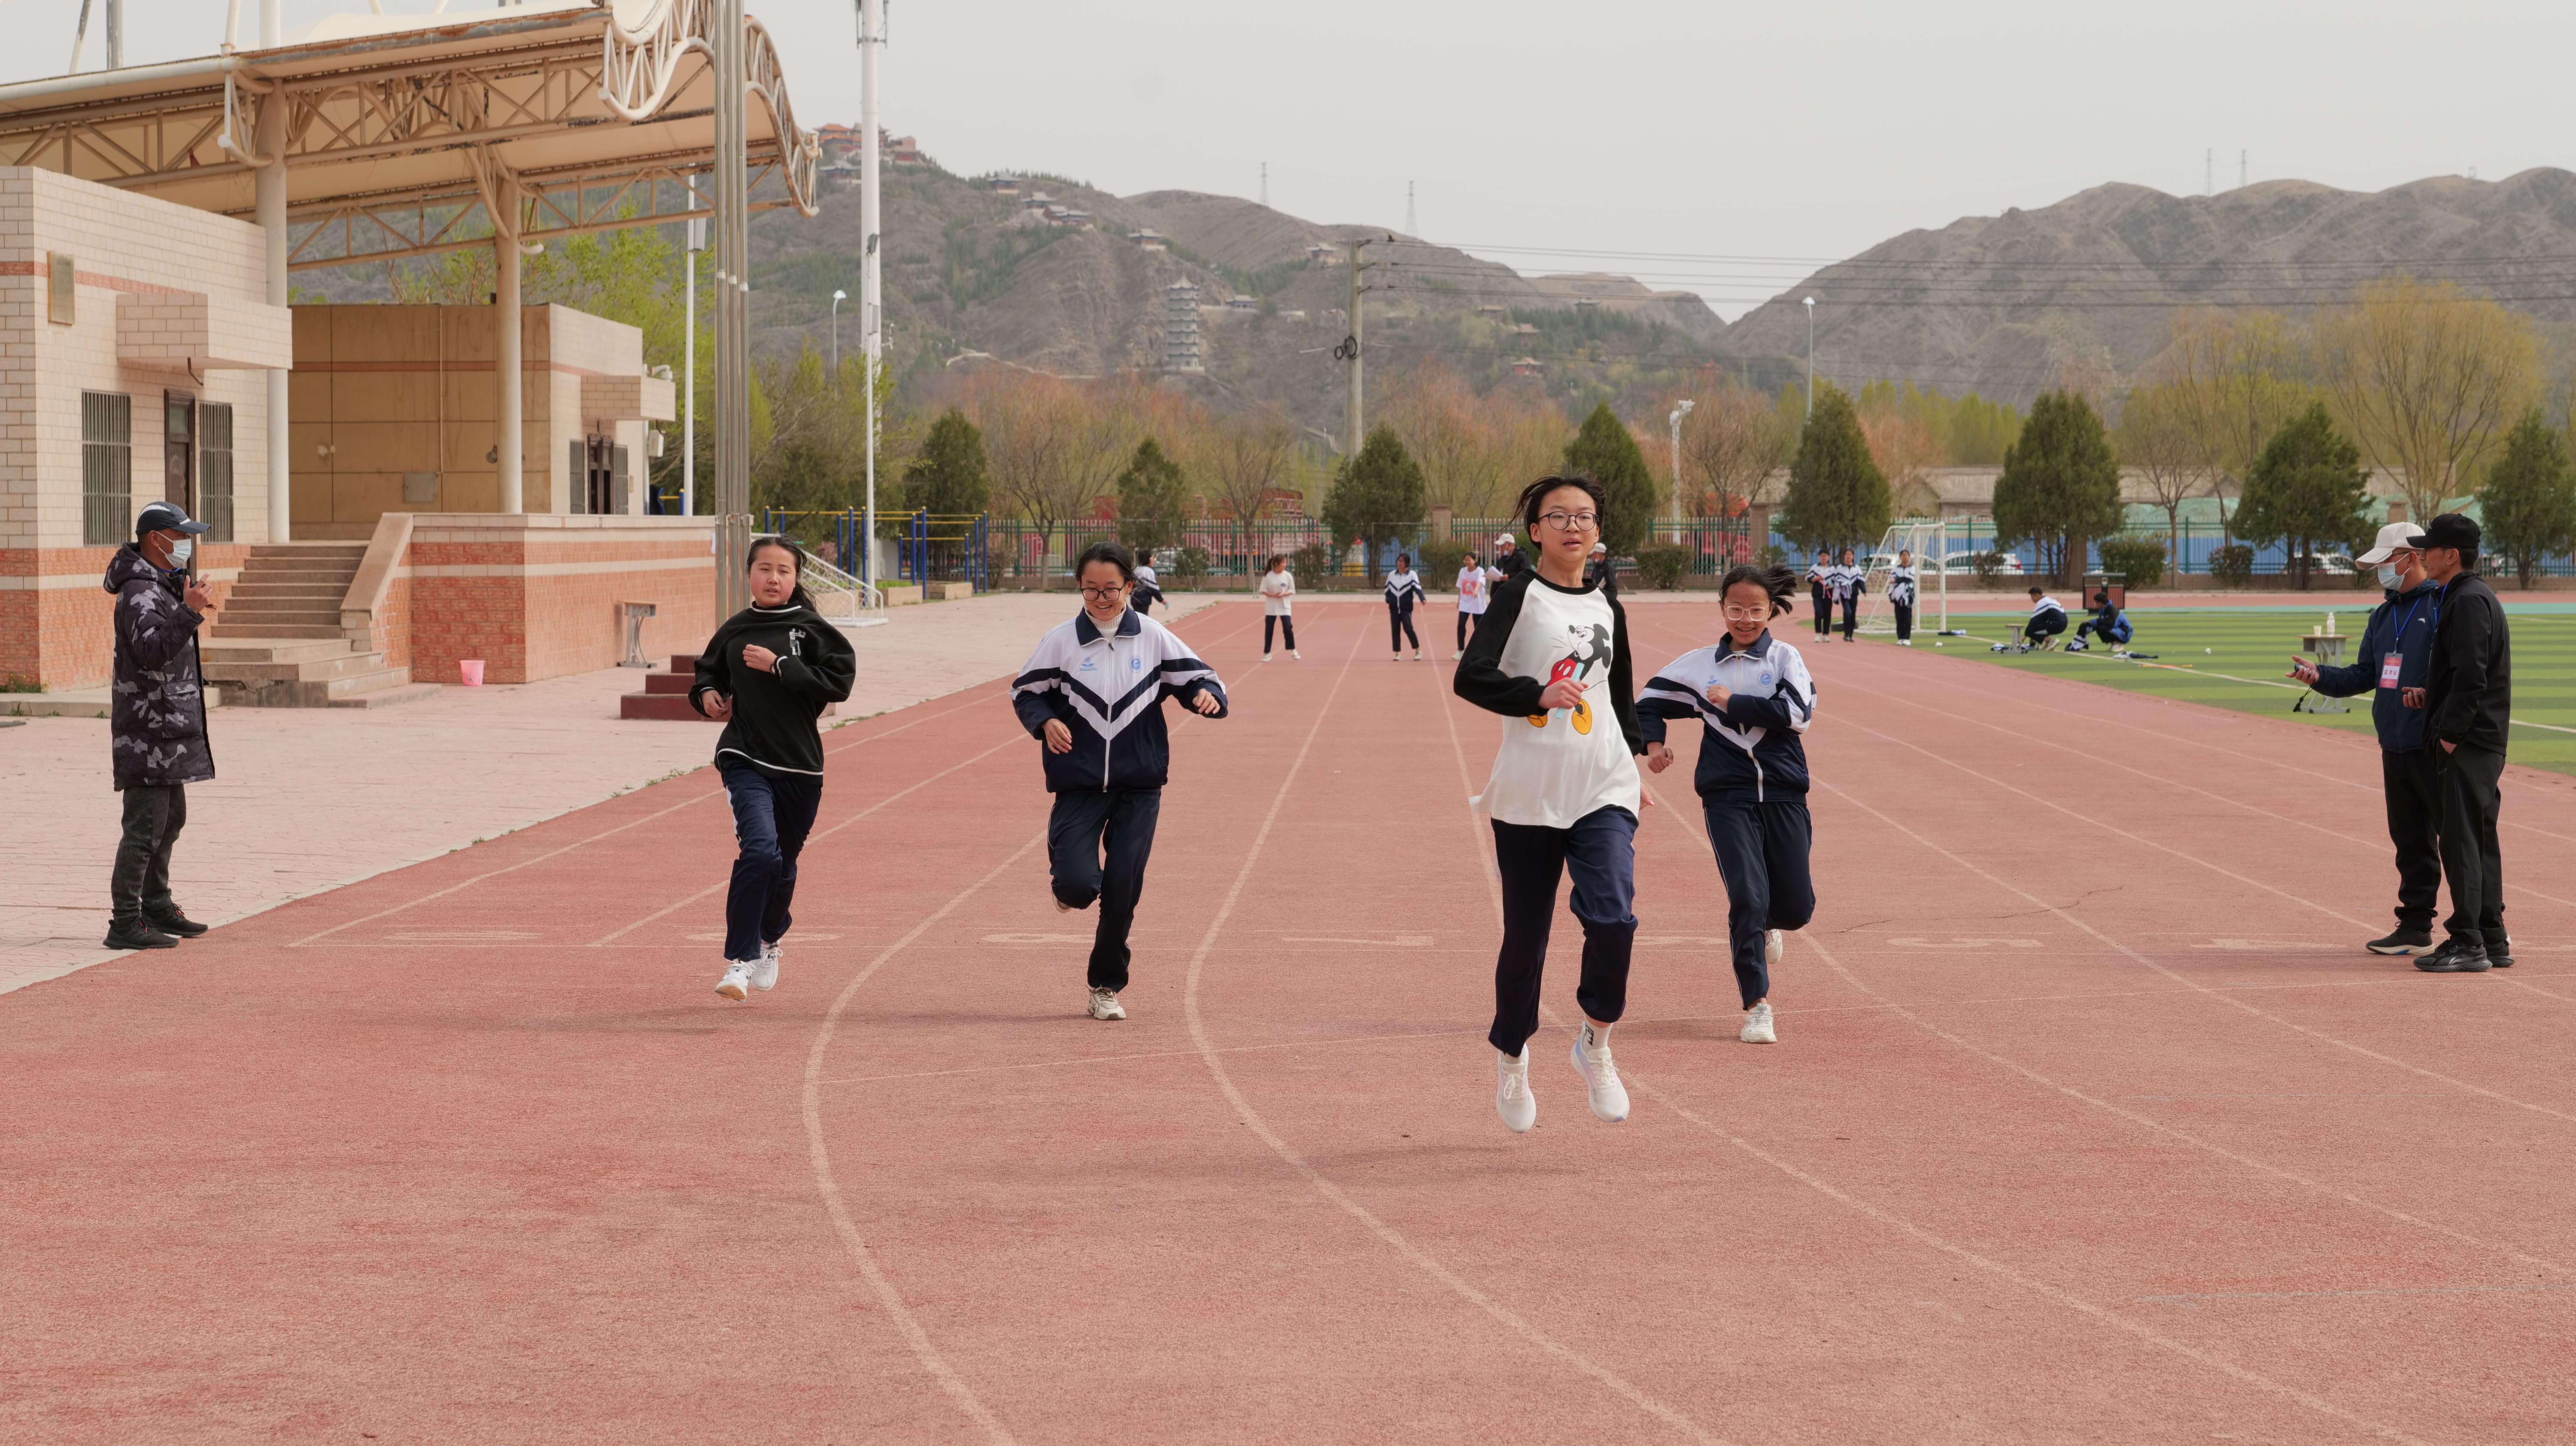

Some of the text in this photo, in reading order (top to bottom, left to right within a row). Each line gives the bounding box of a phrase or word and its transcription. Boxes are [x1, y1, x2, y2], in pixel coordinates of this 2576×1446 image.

[1282, 936, 1434, 946] 7
[1886, 938, 2044, 948] 5
[2191, 939, 2348, 949] 4
